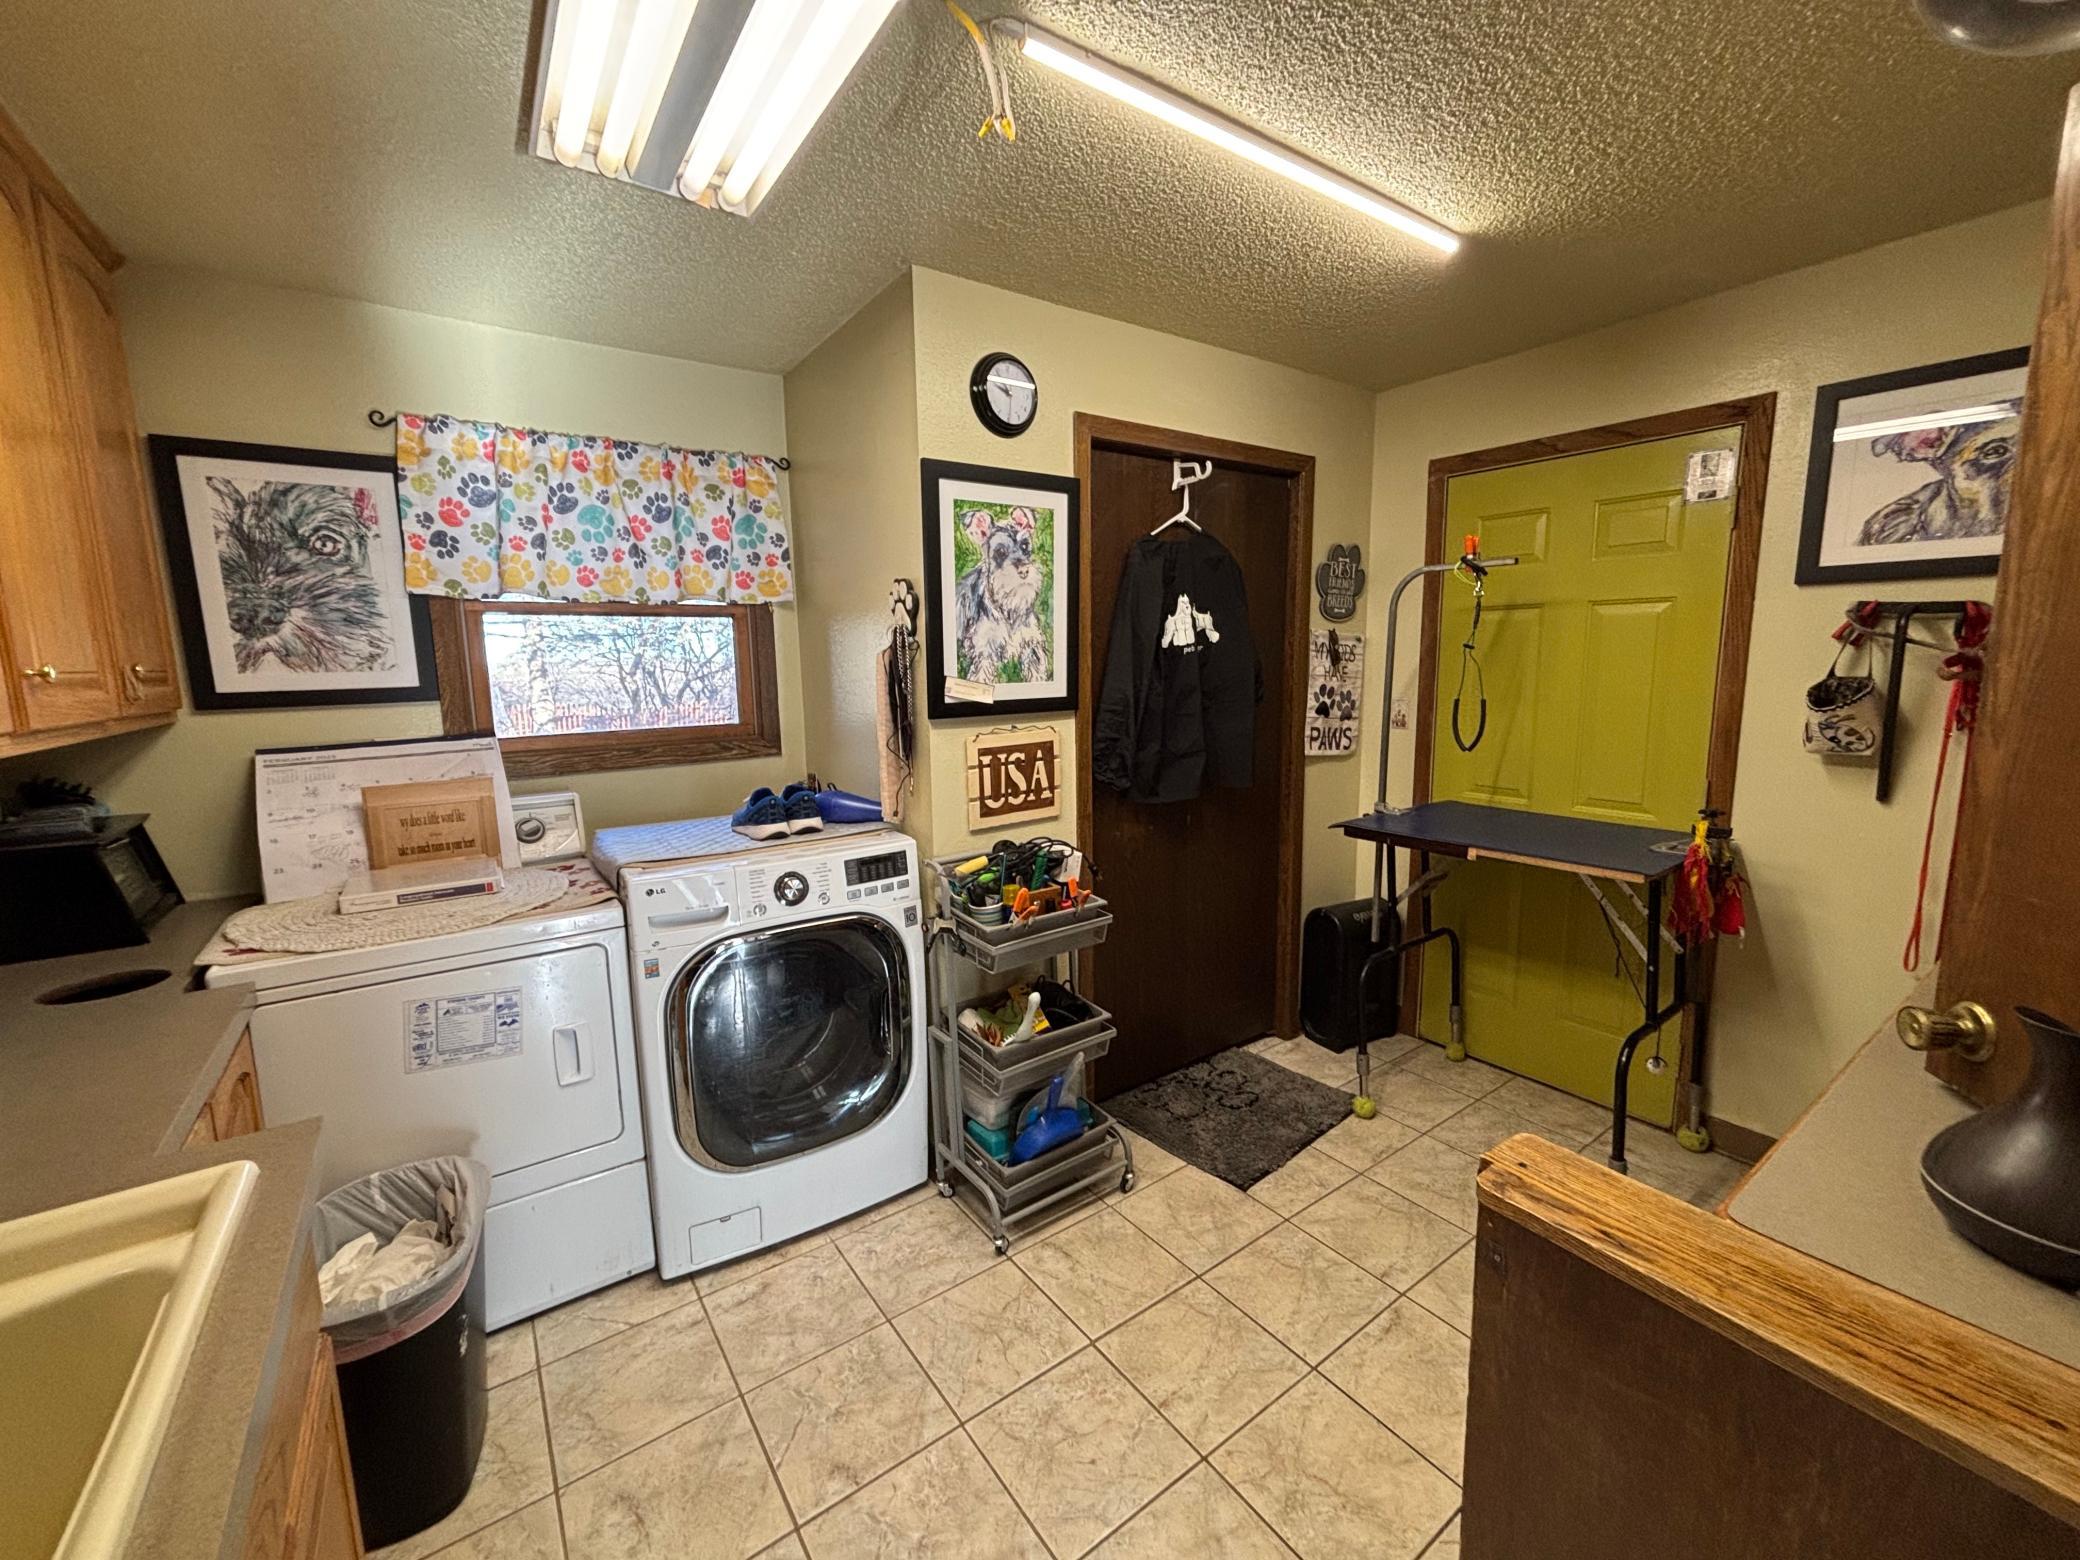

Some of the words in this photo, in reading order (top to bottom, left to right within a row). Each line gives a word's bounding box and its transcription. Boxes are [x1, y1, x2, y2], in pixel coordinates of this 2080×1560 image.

[1330, 561, 1356, 578] BEST
[1328, 577, 1355, 589] FRIENDS
[1327, 594, 1353, 608] BREEDS
[1309, 726, 1353, 751] PAWS
[979, 749, 1053, 809] USA
